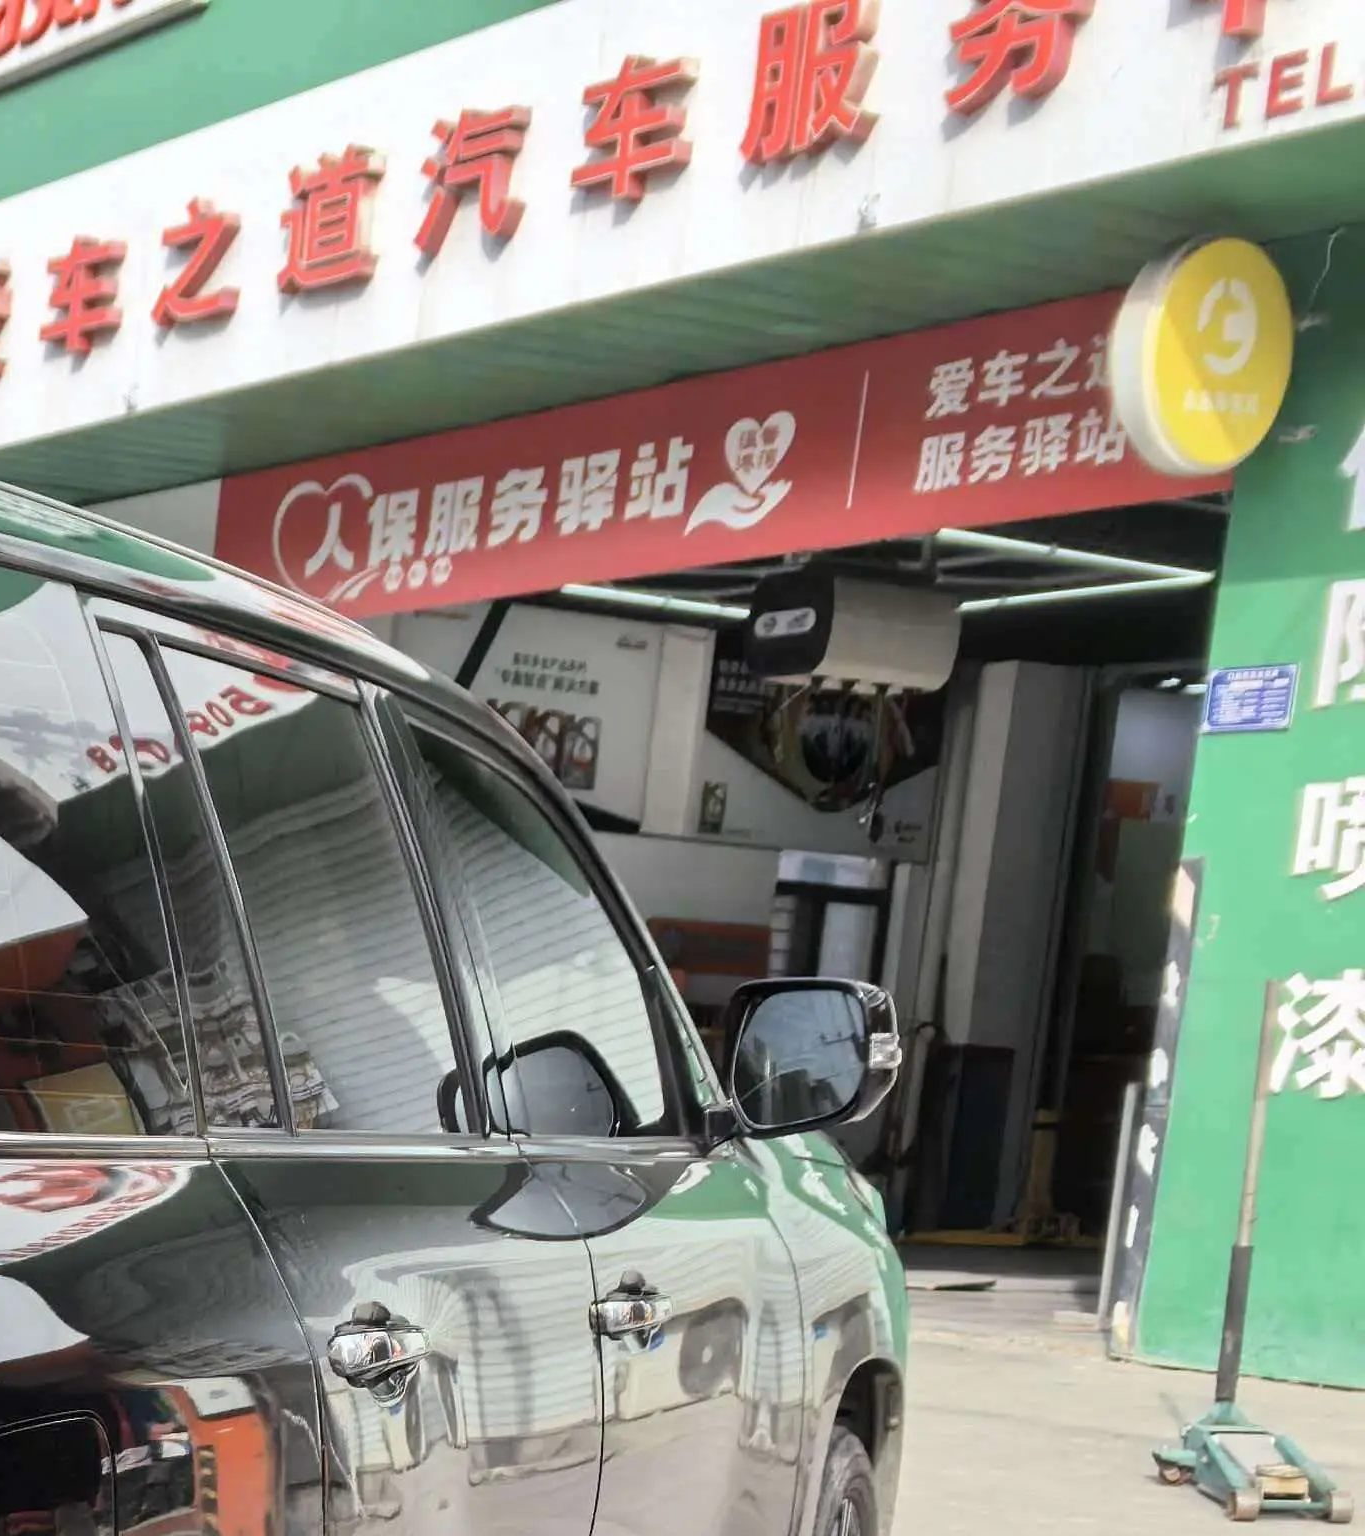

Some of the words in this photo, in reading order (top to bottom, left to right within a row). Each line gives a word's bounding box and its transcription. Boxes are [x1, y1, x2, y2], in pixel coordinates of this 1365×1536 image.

[1215, 42, 1355, 130] TEL
[913, 408, 1128, 493] 服务驿站
[304, 436, 695, 579] 人保服务驿站
